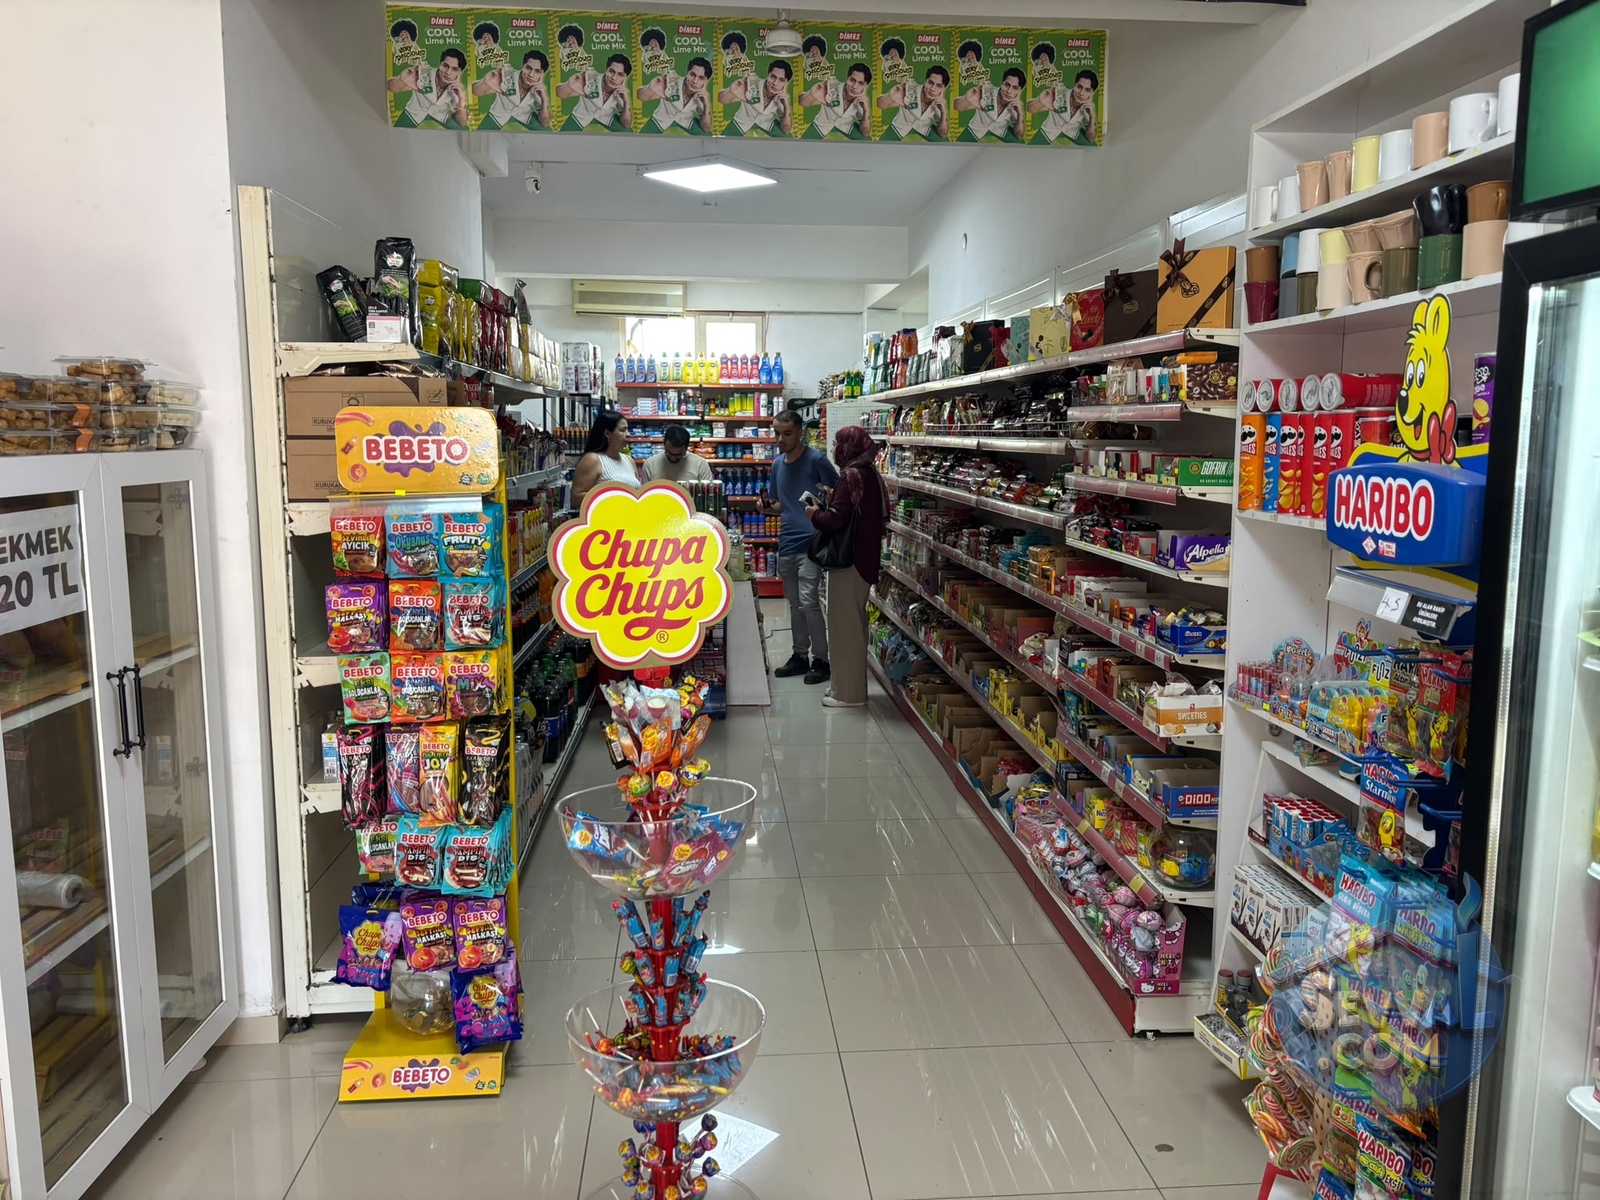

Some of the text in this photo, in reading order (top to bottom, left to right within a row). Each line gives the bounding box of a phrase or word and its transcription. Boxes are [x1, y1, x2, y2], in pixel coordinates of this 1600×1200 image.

[426, 28, 458, 37] COOL
[508, 30, 539, 39] COOL
[592, 33, 623, 42] COOL
[425, 37, 461, 45] Lime Mix
[507, 39, 527, 47] Lime
[611, 42, 626, 50] Mix
[674, 36, 705, 46] COOL
[835, 43, 864, 52] COOL
[913, 45, 943, 55] COOL
[990, 48, 1019, 56] COOL
[833, 52, 852, 60] Lime
[912, 54, 945, 62] Lime Mix
[1008, 56, 1022, 64] Mix
[1064, 50, 1092, 59] COOL
[1062, 59, 1079, 67] Lime
[364, 438, 469, 462] BEBETO
[1335, 475, 1434, 540] HARIBO
[335, 520, 376, 532] BEBETO
[392, 521, 433, 533] BEBETO
[444, 522, 486, 534] BEBETO
[0, 525, 74, 565] EKMEK
[341, 541, 370, 550] AYICIK
[443, 535, 486, 547] FRUITY
[579, 529, 707, 578] Chupa
[1187, 544, 1224, 562] Alpella
[0, 562, 79, 614] 20 TL
[332, 596, 373, 608] BEBETO
[395, 597, 436, 608] BEBETO
[450, 595, 490, 606] BEBETO
[576, 572, 705, 641] Chups
[343, 666, 384, 678] BEBETO
[397, 666, 439, 678] BEBETO
[450, 664, 490, 675] BEBETO
[1394, 661, 1419, 676] HARI
[1178, 711, 1207, 720] SWEETIES
[340, 745, 372, 755] BEBETO
[465, 746, 497, 756] BEBETO
[401, 834, 437, 844] BEBETO
[452, 837, 490, 847] BEBETO
[1339, 872, 1377, 908] HARIBO
[408, 912, 447, 928] BEBETO
[460, 911, 499, 925] BEBETO
[1348, 980, 1388, 1008] HARIB
[392, 1066, 451, 1085] BEBETO
[1358, 1130, 1405, 1177] HARIBO
